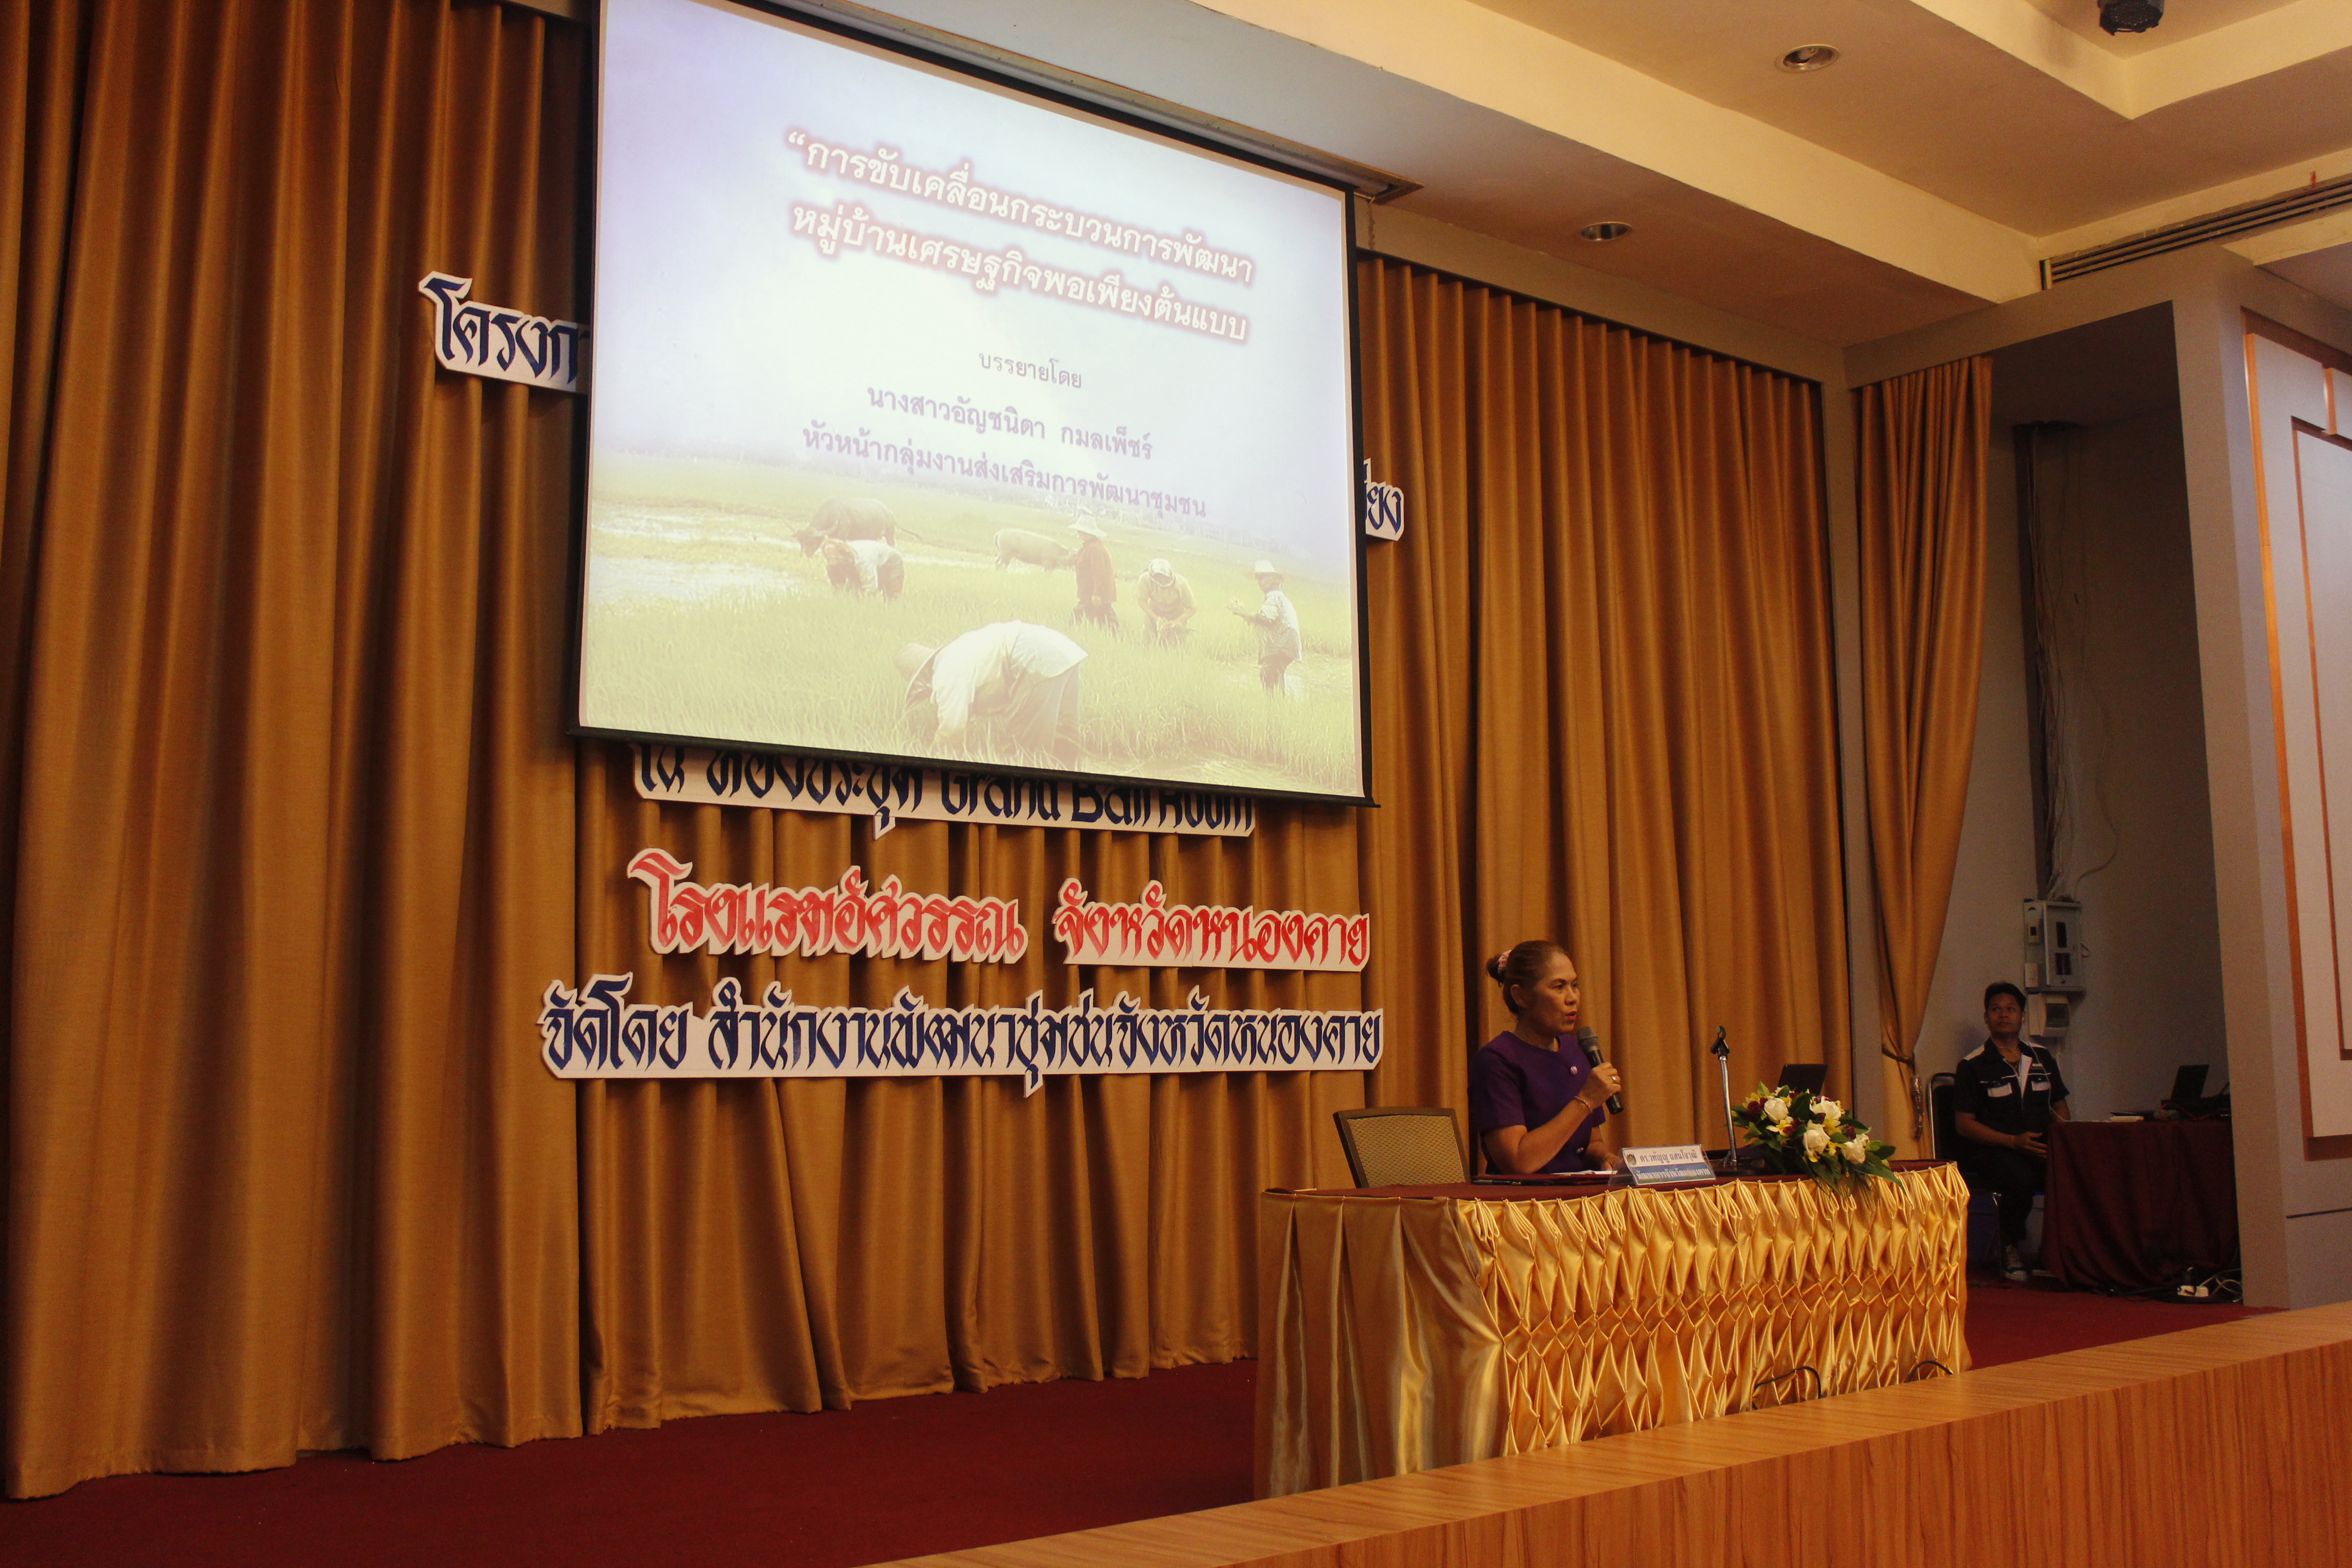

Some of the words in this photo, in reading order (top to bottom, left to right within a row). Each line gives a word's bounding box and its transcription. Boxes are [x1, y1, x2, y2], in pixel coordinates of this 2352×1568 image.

[794, 205, 1246, 340] หมู่บ้านเศรษฐกิจพอเพียงต้นแบบ
[979, 352, 1083, 388] บรรยายโดย
[867, 387, 1045, 439] นางสาวอัญชนิดา
[1060, 426, 1152, 460] กมลเพ็ชร์
[1055, 882, 1368, 966] จังหวัดหนองคาย
[544, 977, 689, 1071] จัดโดย
